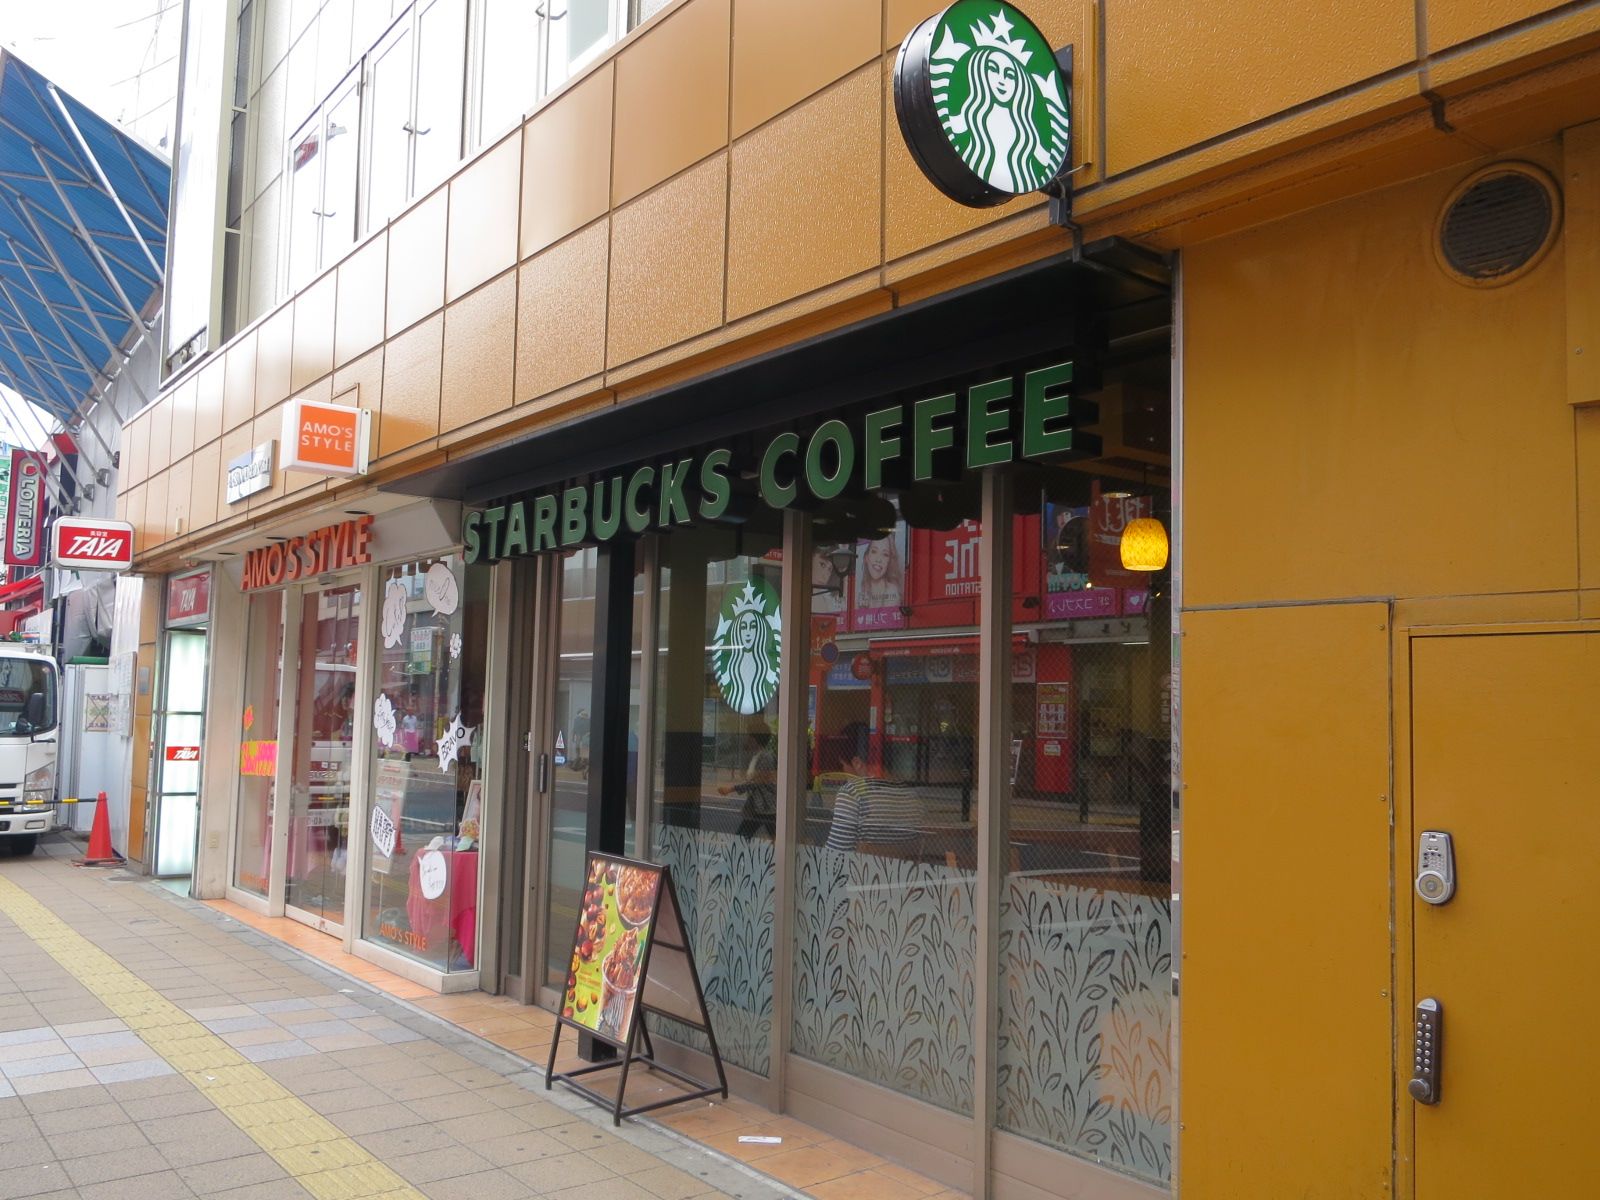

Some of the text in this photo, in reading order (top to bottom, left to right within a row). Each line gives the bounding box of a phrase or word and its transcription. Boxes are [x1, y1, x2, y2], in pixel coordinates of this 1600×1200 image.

[301, 434, 353, 452] STYLE
[302, 421, 353, 439] AMO'S
[462, 360, 1074, 566] STARBUCKS COFFEE
[16, 478, 35, 556] LOTTERIA
[66, 535, 124, 558] TAYA
[240, 515, 376, 591] AMO'S STYLE
[180, 587, 197, 613] TAYA
[173, 749, 198, 760] TAYA
[440, 727, 466, 761] BRAVO
[380, 922, 427, 951] AMO'S STYLE
